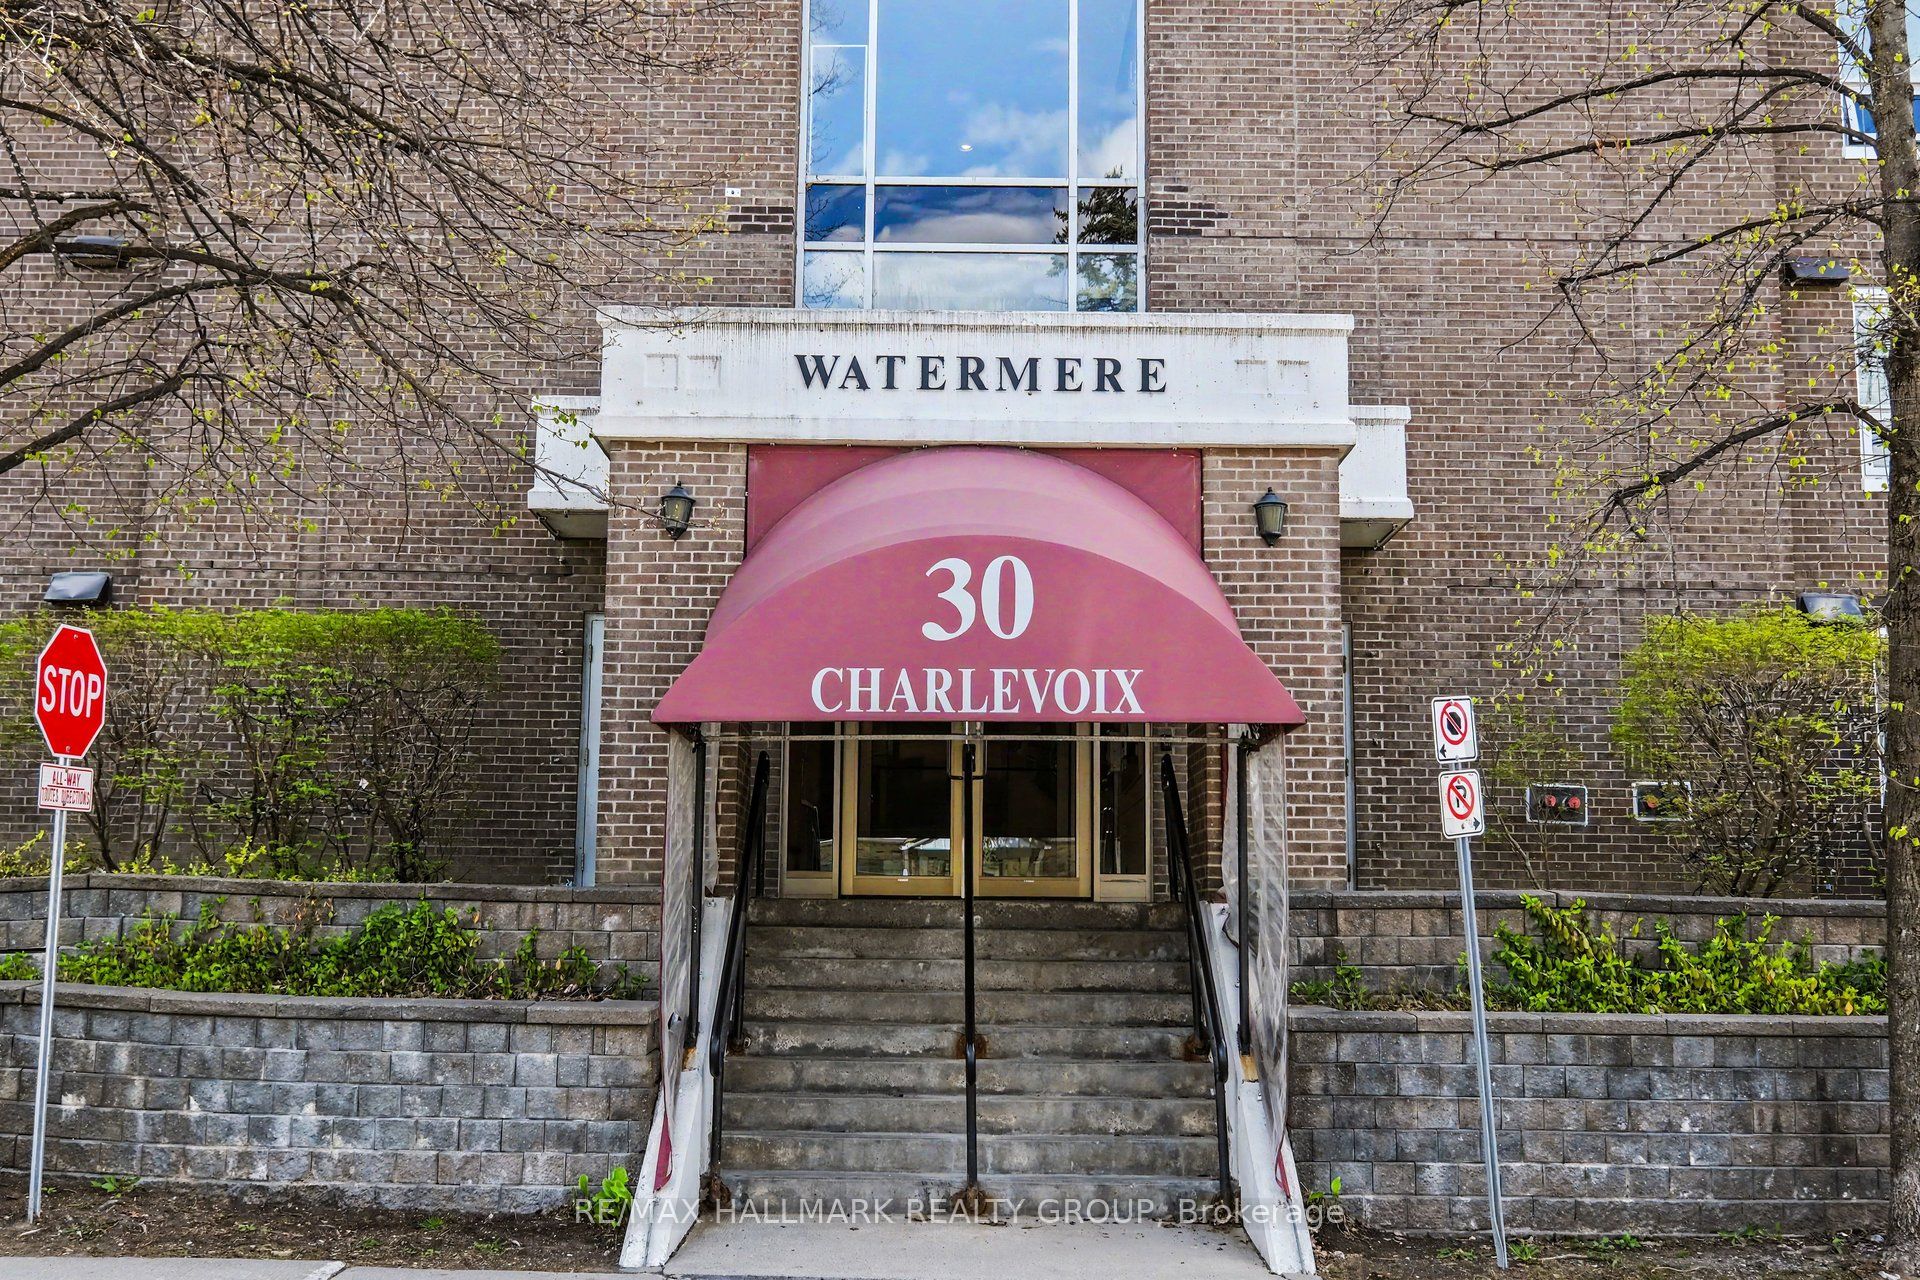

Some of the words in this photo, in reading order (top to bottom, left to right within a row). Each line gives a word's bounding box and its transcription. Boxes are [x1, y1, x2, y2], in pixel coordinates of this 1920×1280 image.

[794, 354, 1168, 393] WATERMERE
[921, 555, 1035, 642] 30
[41, 664, 102, 719] STOP
[811, 667, 1146, 715] CHARLEVOIX
[52, 770, 82, 787] ALL-WAY
